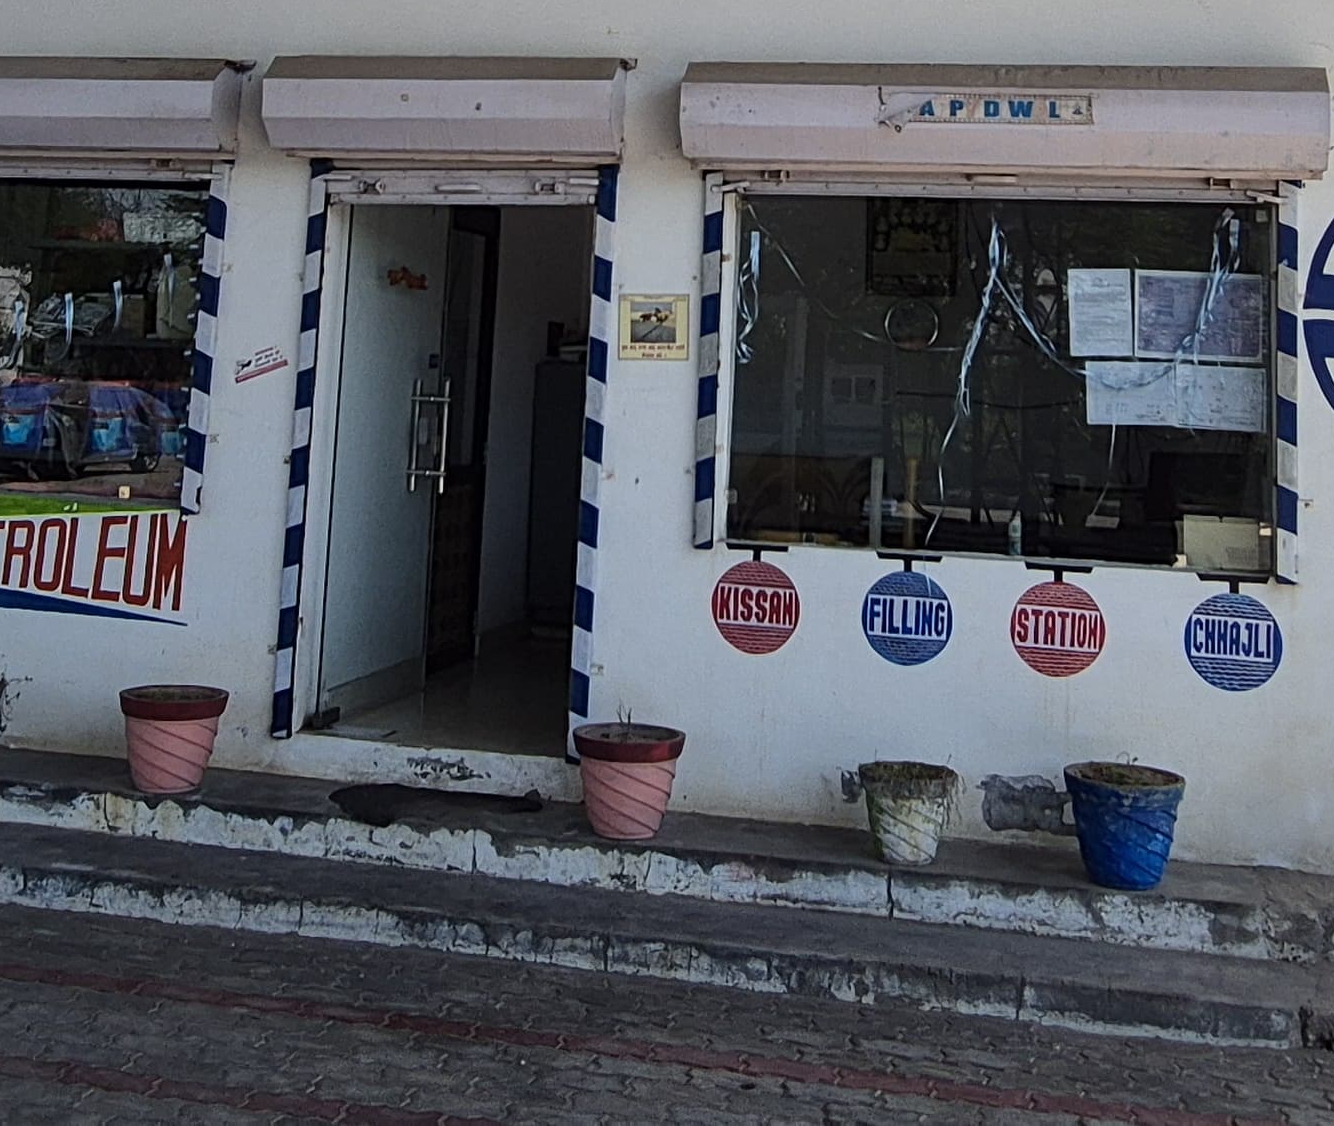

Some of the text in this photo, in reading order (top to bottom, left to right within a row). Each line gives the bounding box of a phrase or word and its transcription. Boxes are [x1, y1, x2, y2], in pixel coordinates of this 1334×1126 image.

[718, 586, 1274, 658] KISSAN FILLING STATION CHHAJLI
